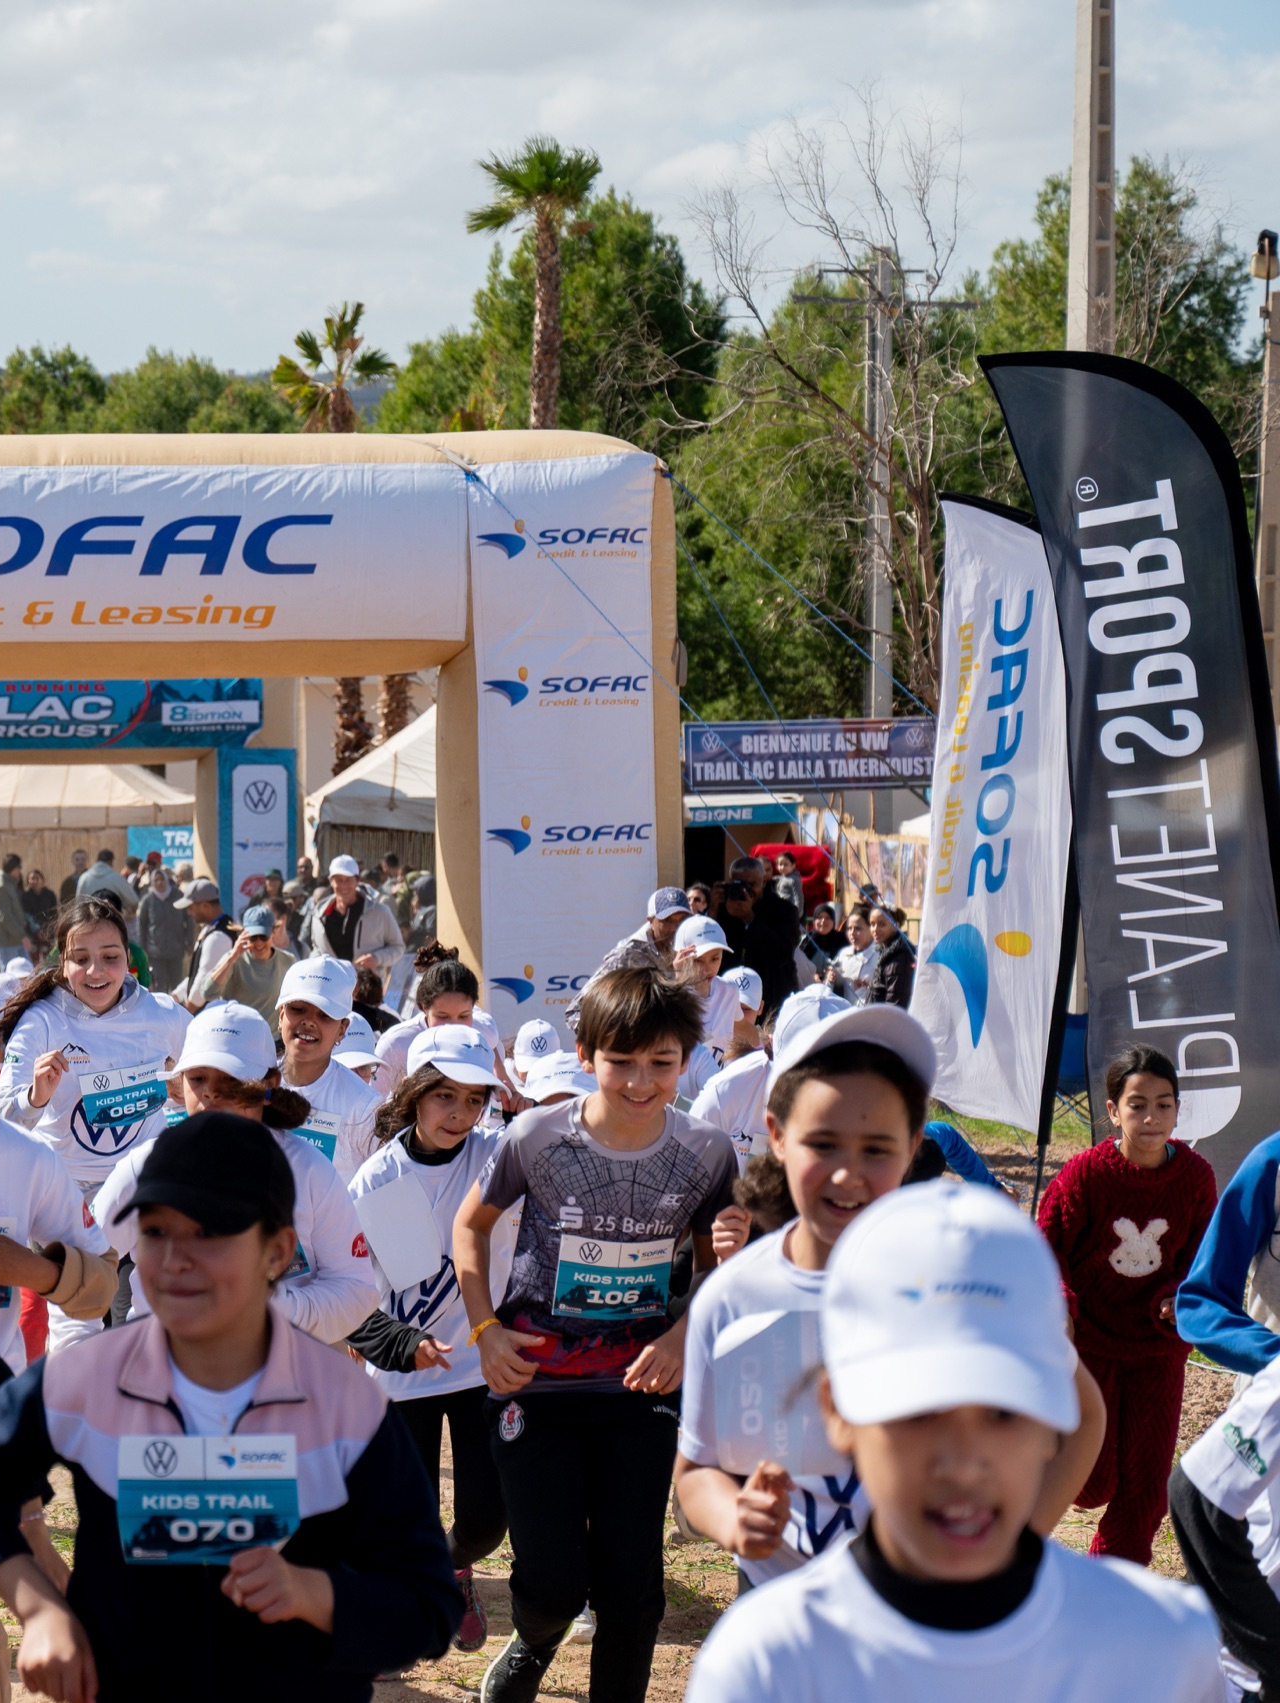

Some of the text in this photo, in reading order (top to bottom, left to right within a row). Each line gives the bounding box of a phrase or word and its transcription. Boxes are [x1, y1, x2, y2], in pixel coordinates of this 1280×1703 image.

[537, 528, 648, 546] SOFAC
[22, 601, 55, 625] &
[71, 594, 277, 629] Leasing
[5, 682, 106, 693] RUNNING
[539, 675, 649, 694] SOFAC
[742, 732, 832, 754] BIENVENUE
[860, 731, 890, 751] VW
[694, 757, 935, 782] TRAIL LAC LALLA TAKERKOUST
[542, 823, 653, 842] SOFAC
[96, 1087, 157, 1107] KIDS TRAIL
[109, 1099, 149, 1118] 065
[593, 1215, 616, 1232] 25
[622, 1215, 674, 1235] Berlin
[641, 1248, 668, 1258] SOFAC
[573, 1272, 656, 1285] KIDS TRAIL
[587, 1290, 641, 1305] 106
[239, 1452, 287, 1464] SOFAC
[141, 1494, 274, 1511] KIDS TRAIL
[169, 1518, 255, 1543] 070
